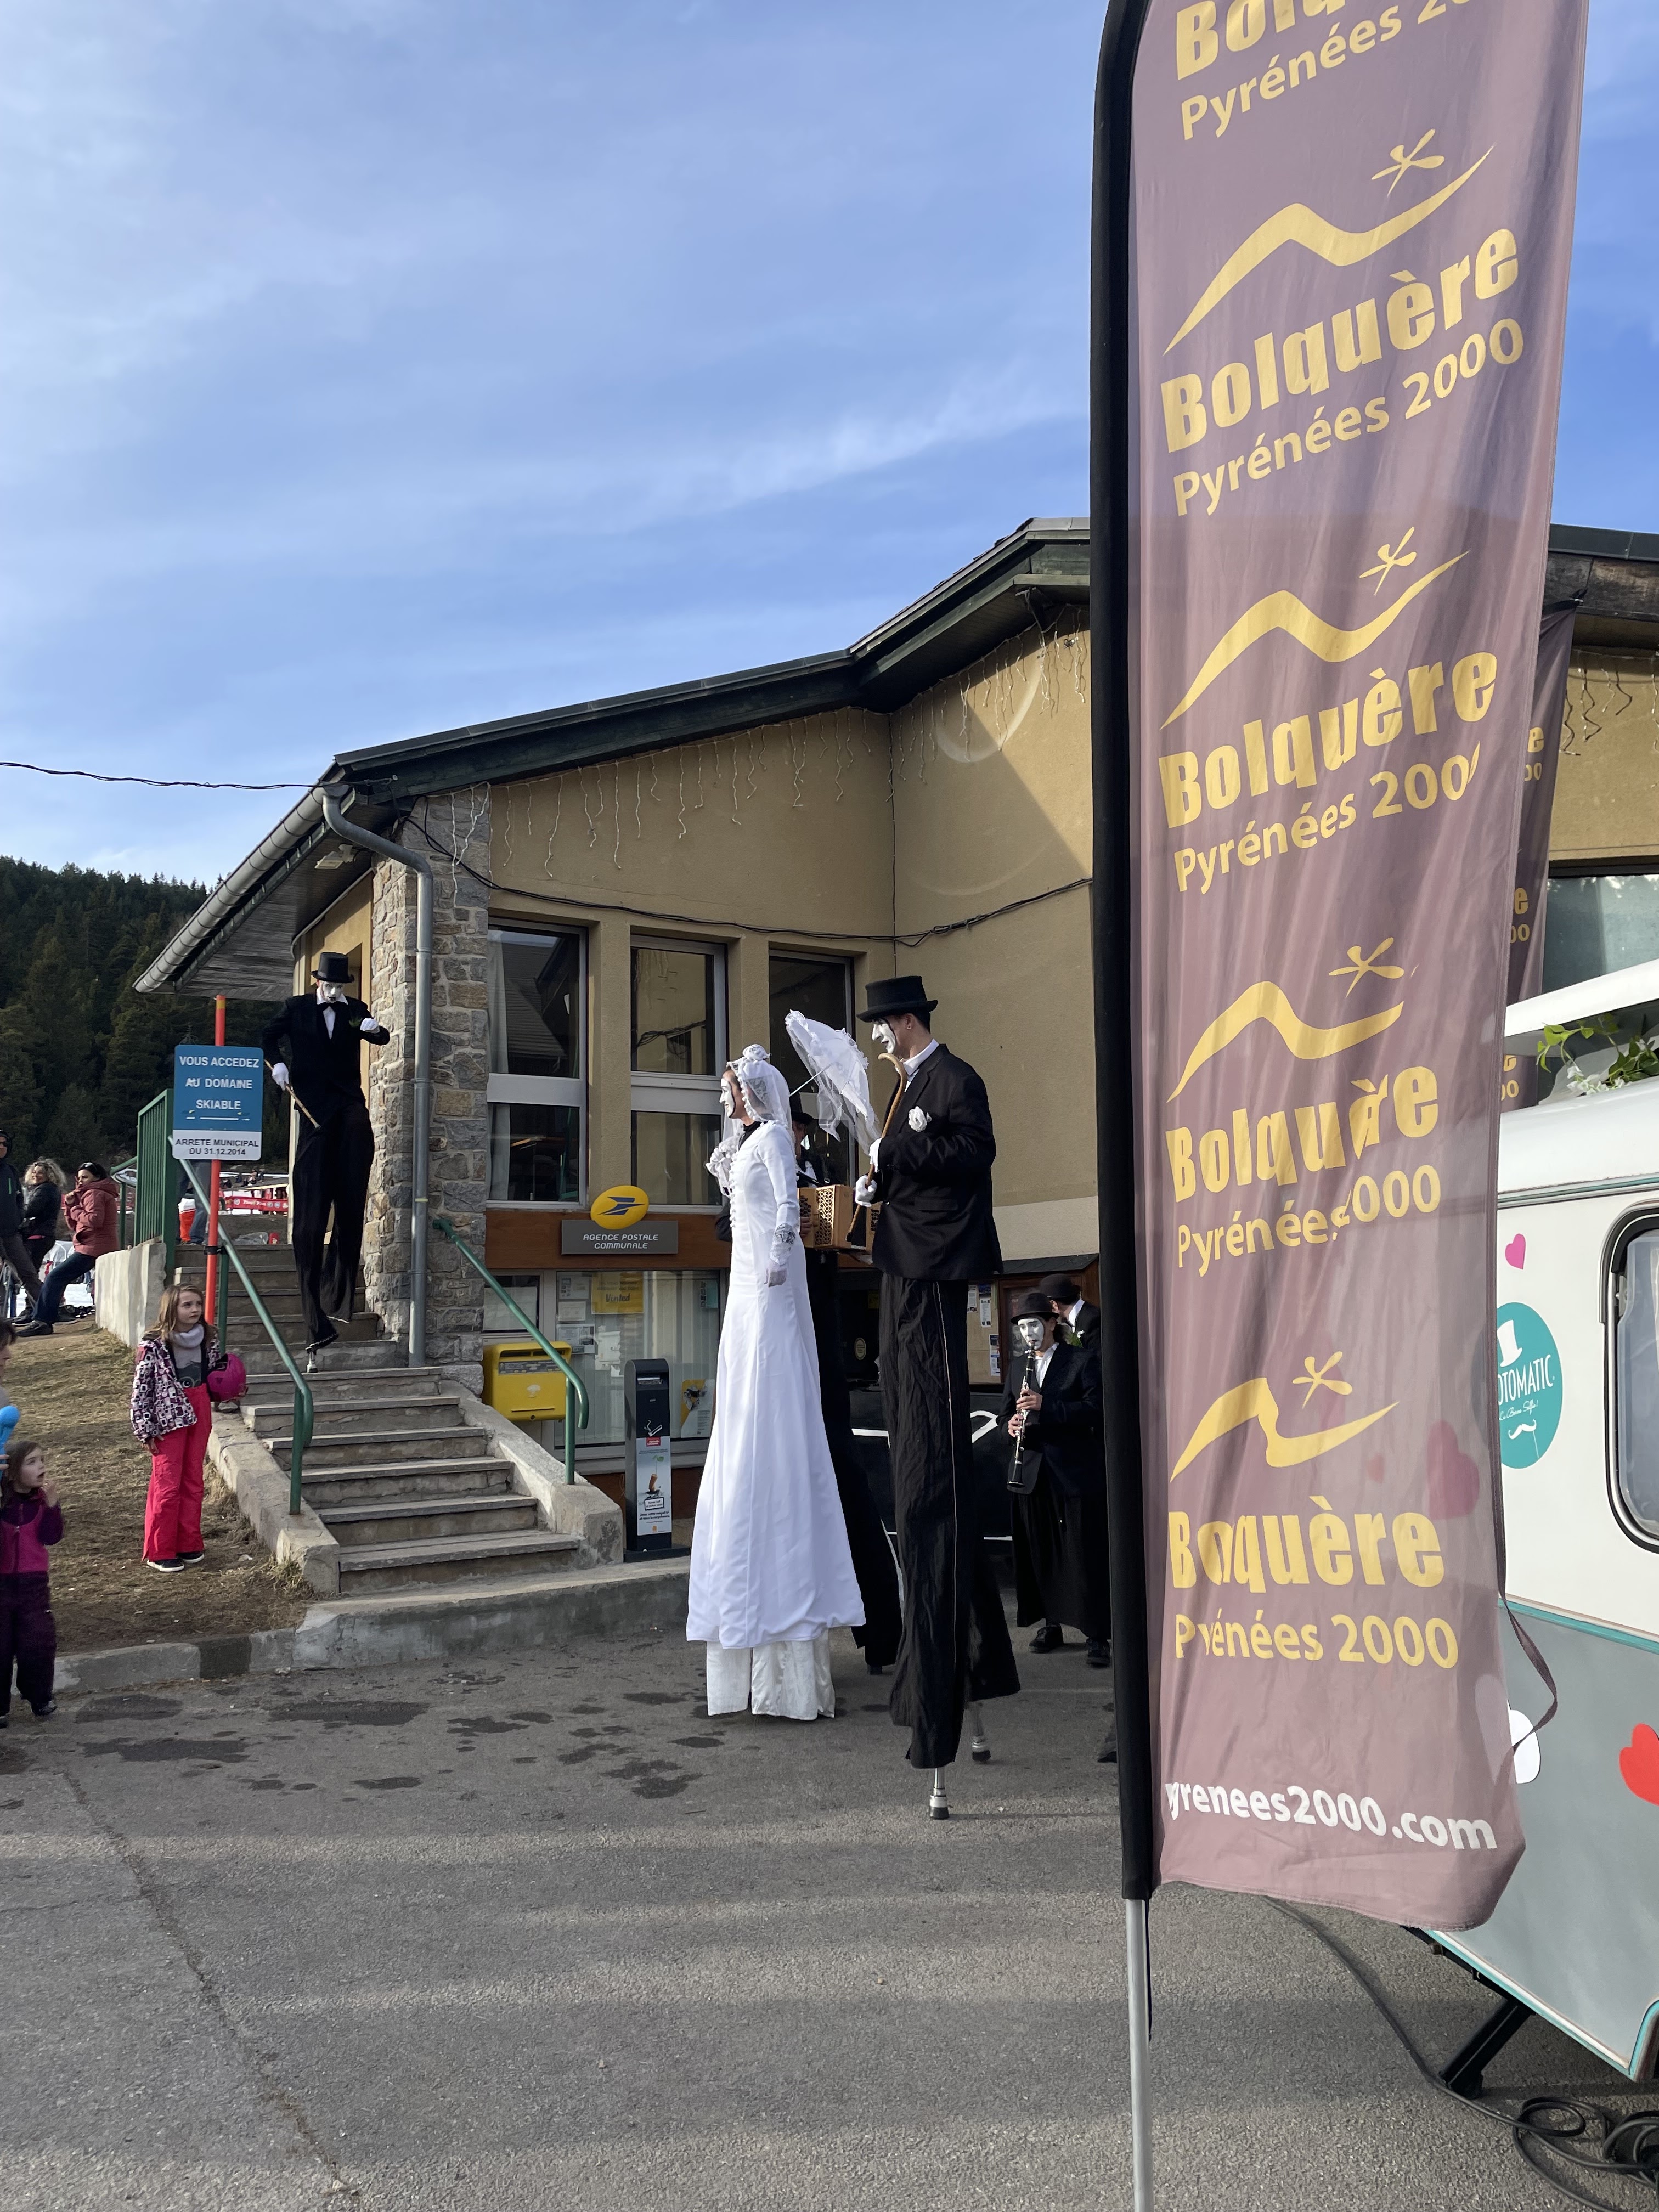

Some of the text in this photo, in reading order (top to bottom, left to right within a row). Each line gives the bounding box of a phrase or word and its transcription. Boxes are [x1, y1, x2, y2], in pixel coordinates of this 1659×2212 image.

[1181, 5, 1402, 141] Pyrénées
[1161, 228, 1519, 453] Bolquère
[1173, 318, 1523, 517] Pyrénées 2000
[1158, 651, 1497, 829] Bolquère
[1173, 793, 1357, 895] Pyrénées
[179, 1056, 259, 1068] VOUS ACCEDEZ
[185, 1077, 252, 1089] AU DOMAINE
[196, 1099, 241, 1110] SKIABLE
[1340, 1164, 1441, 1229] 000
[1331, 1614, 1458, 1669] 2000
